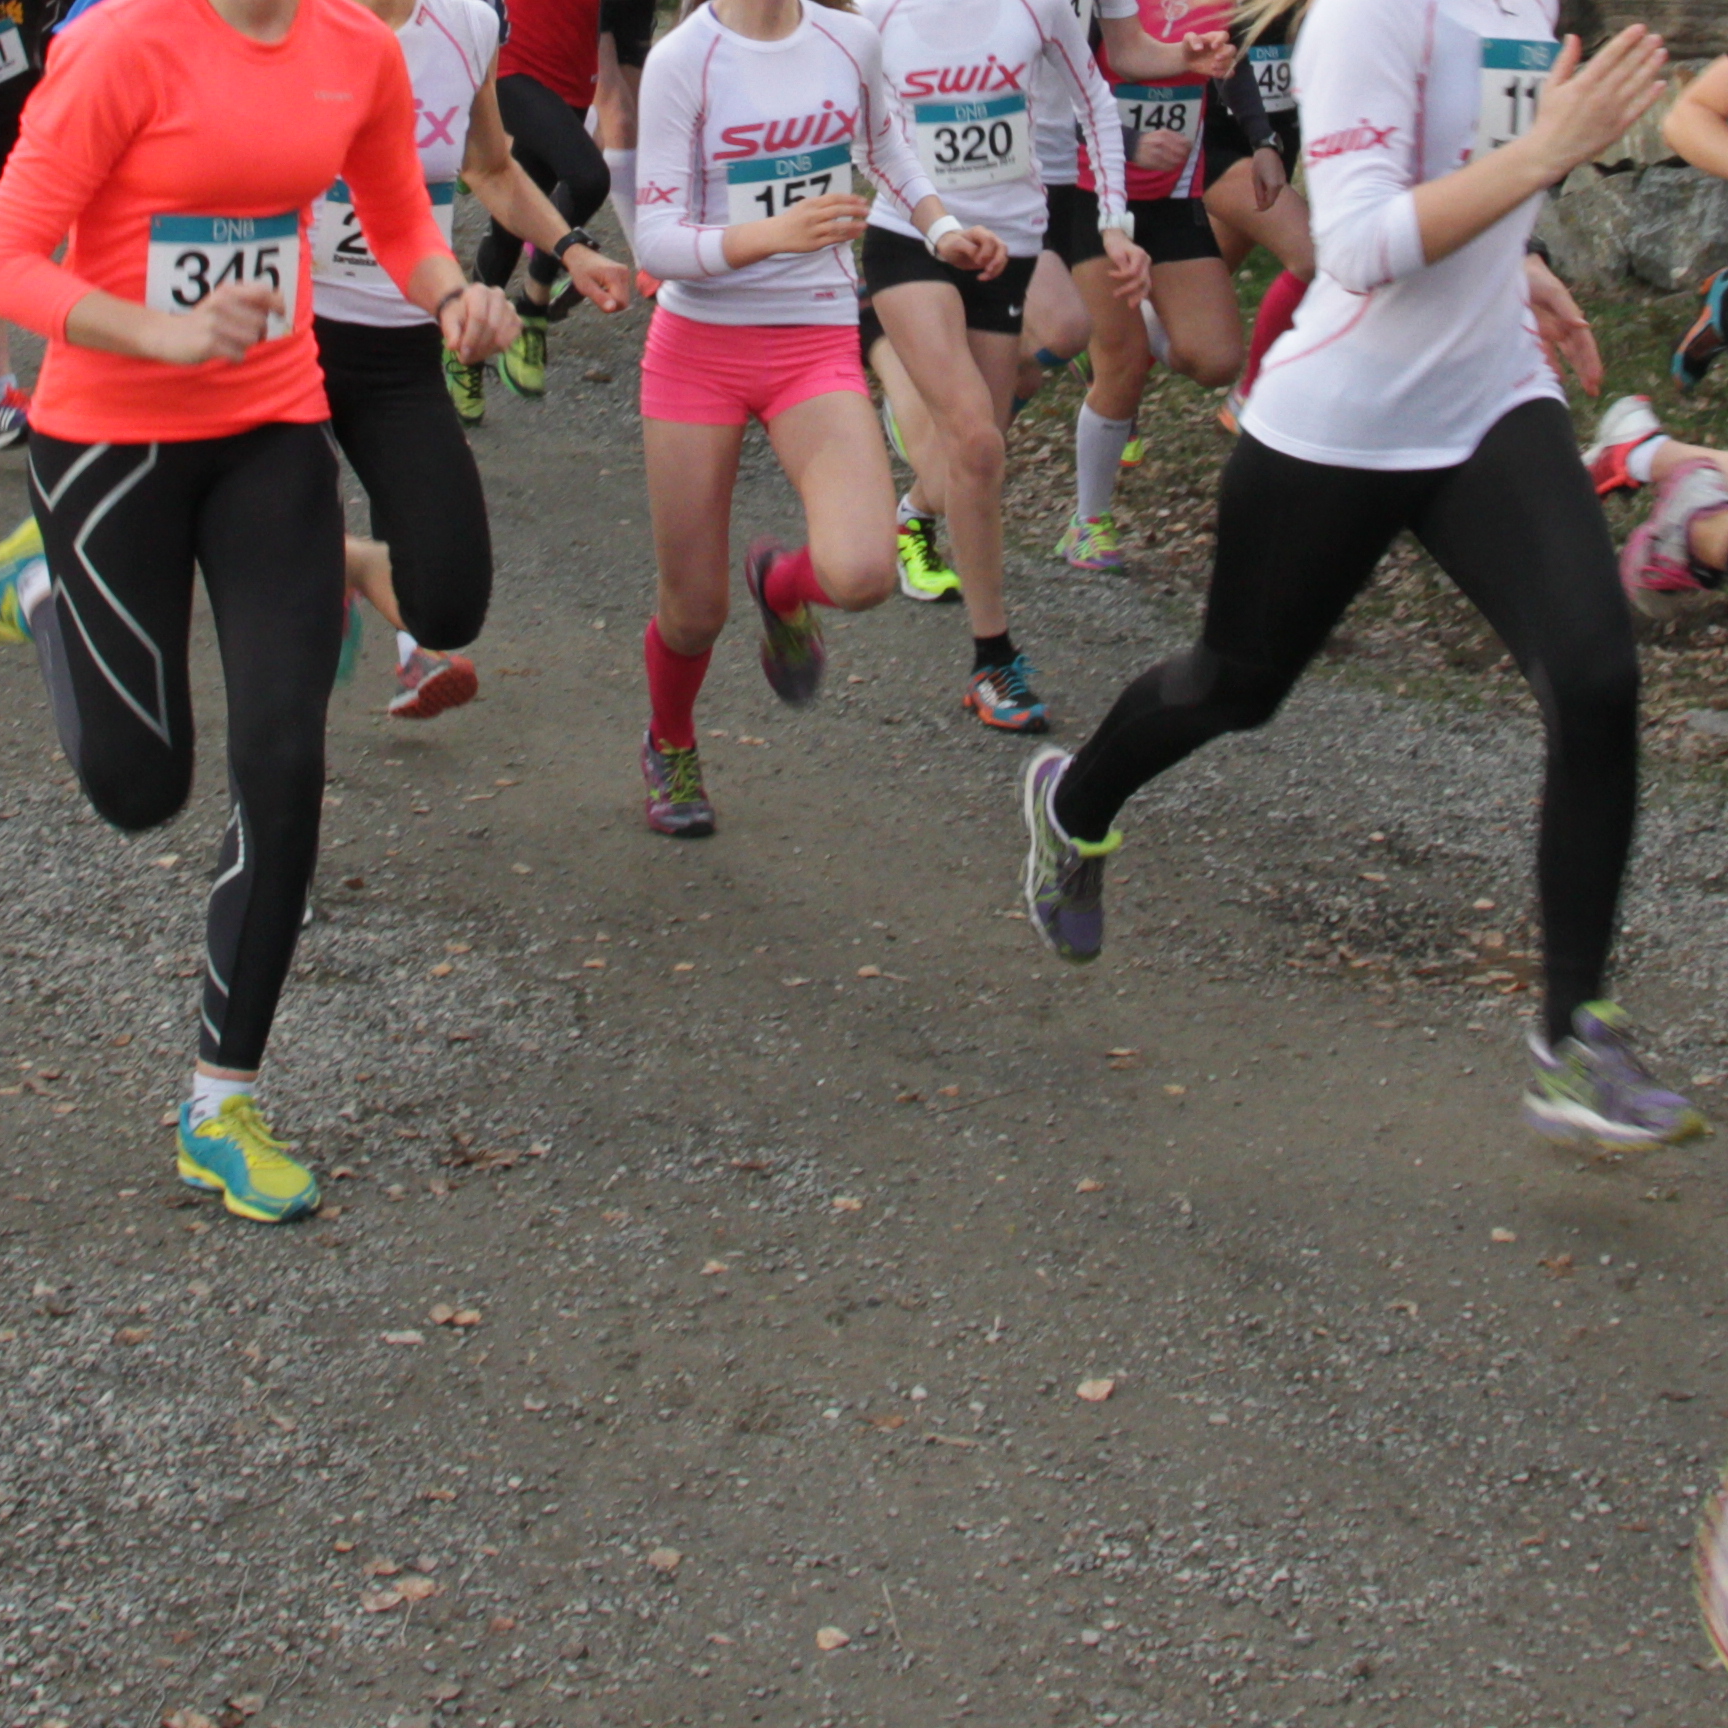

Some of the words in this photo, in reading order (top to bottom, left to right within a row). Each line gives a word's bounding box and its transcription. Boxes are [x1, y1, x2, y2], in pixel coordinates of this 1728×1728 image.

[1258, 63, 1291, 92] 49
[955, 100, 988, 123] DNB
[1129, 103, 1187, 132] 148
[934, 121, 1012, 163] 320
[776, 155, 813, 177] DNB
[213, 217, 254, 245] DNB
[172, 244, 280, 307] 345
